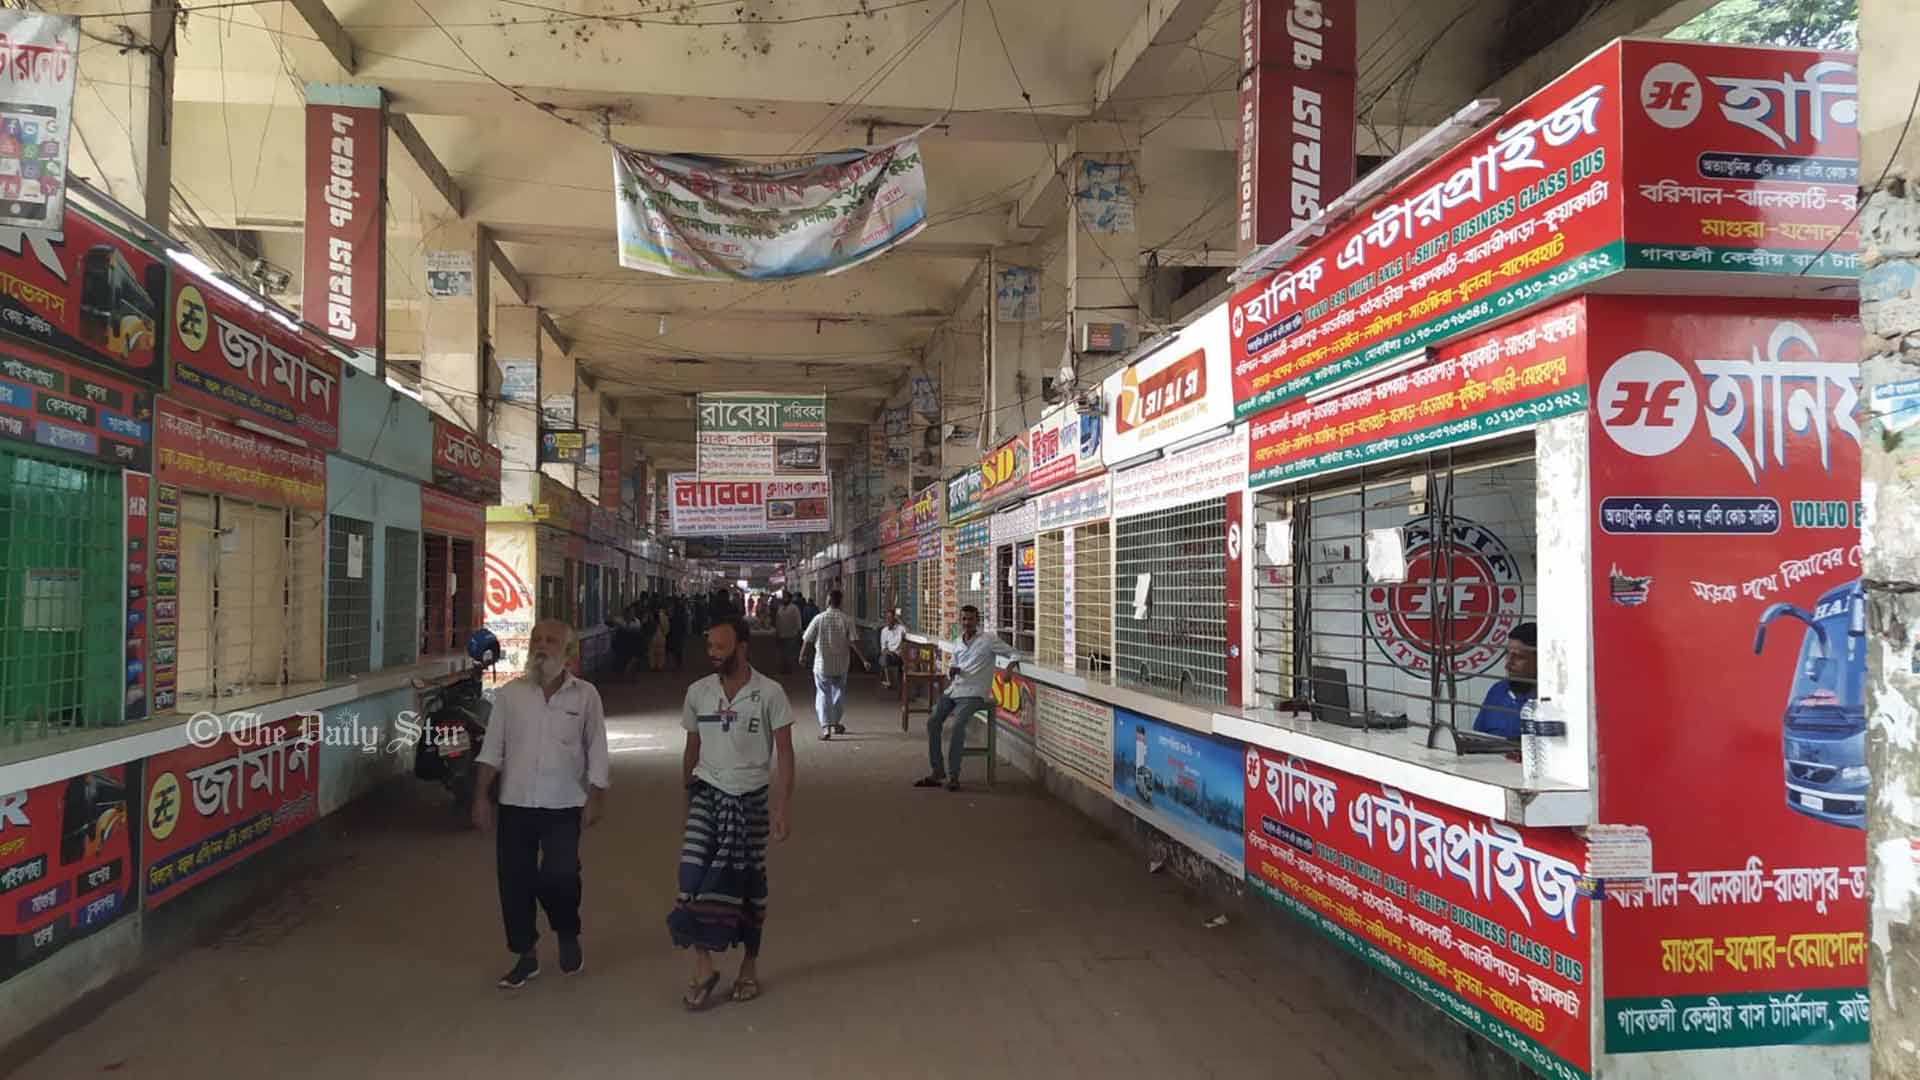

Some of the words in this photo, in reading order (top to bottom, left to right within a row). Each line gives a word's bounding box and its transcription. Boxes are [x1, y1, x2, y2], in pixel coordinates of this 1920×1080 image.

[1245, 256, 1325, 326] হানিফ
[1337, 84, 1604, 270] এন্টারপ্রাইজ
[1453, 194, 1514, 246] BUSINESS
[1520, 167, 1566, 211] CLASS
[1571, 144, 1605, 184] BUS
[1640, 247, 1713, 264] গাবতলী
[211, 314, 338, 412] জামান
[698, 400, 782, 428] রাবেয়া
[783, 401, 824, 421] পরিবহন
[1605, 505, 1652, 528] অত্যাধুনিক
[1654, 504, 1674, 524] এসি
[1704, 504, 1723, 524] এসি
[1791, 501, 1848, 529] VOLVO
[1780, 546, 1843, 589] বিমানের
[186, 737, 311, 818] জামান
[1262, 757, 1338, 831] হানিফ
[1349, 784, 1580, 936] এন্টারপ্রাইজ
[1451, 903, 1505, 949] BUSINESS
[1509, 929, 1551, 970] CLASS
[1554, 950, 1583, 987] BUS
[1617, 1000, 1677, 1037] গাবতলী
[1681, 997, 1735, 1035] কেন্দ্রীয়
[1738, 1002, 1765, 1031] বাস
